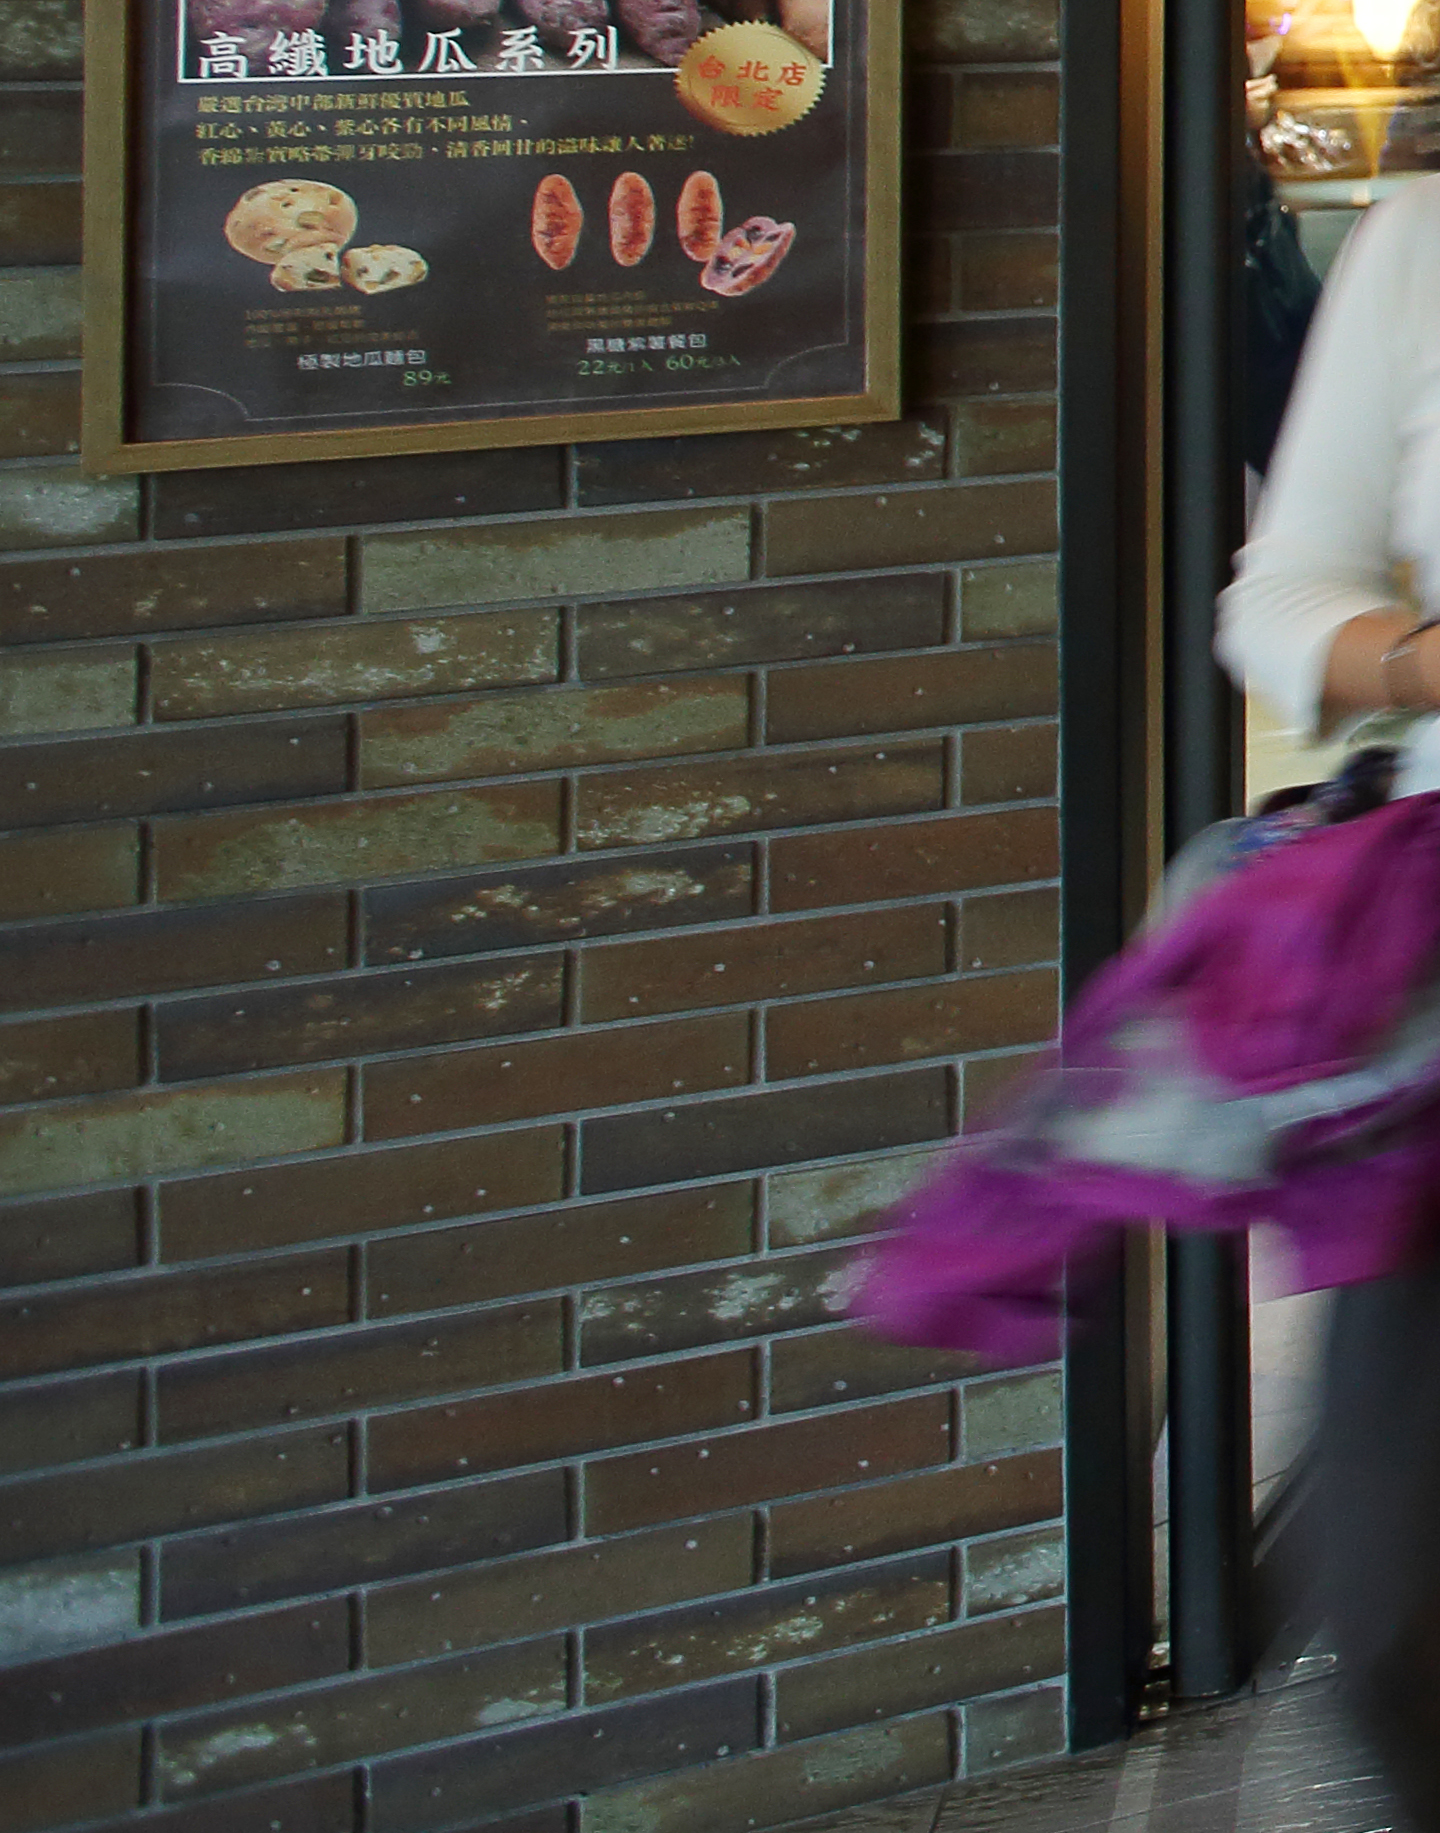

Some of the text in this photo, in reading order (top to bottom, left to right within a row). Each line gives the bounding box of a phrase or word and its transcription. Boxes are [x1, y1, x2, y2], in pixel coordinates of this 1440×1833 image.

[199, 24, 620, 78] 高纖地瓜系列
[698, 54, 808, 87] 台北店
[709, 84, 785, 112] 限定
[402, 369, 453, 387] 89元
